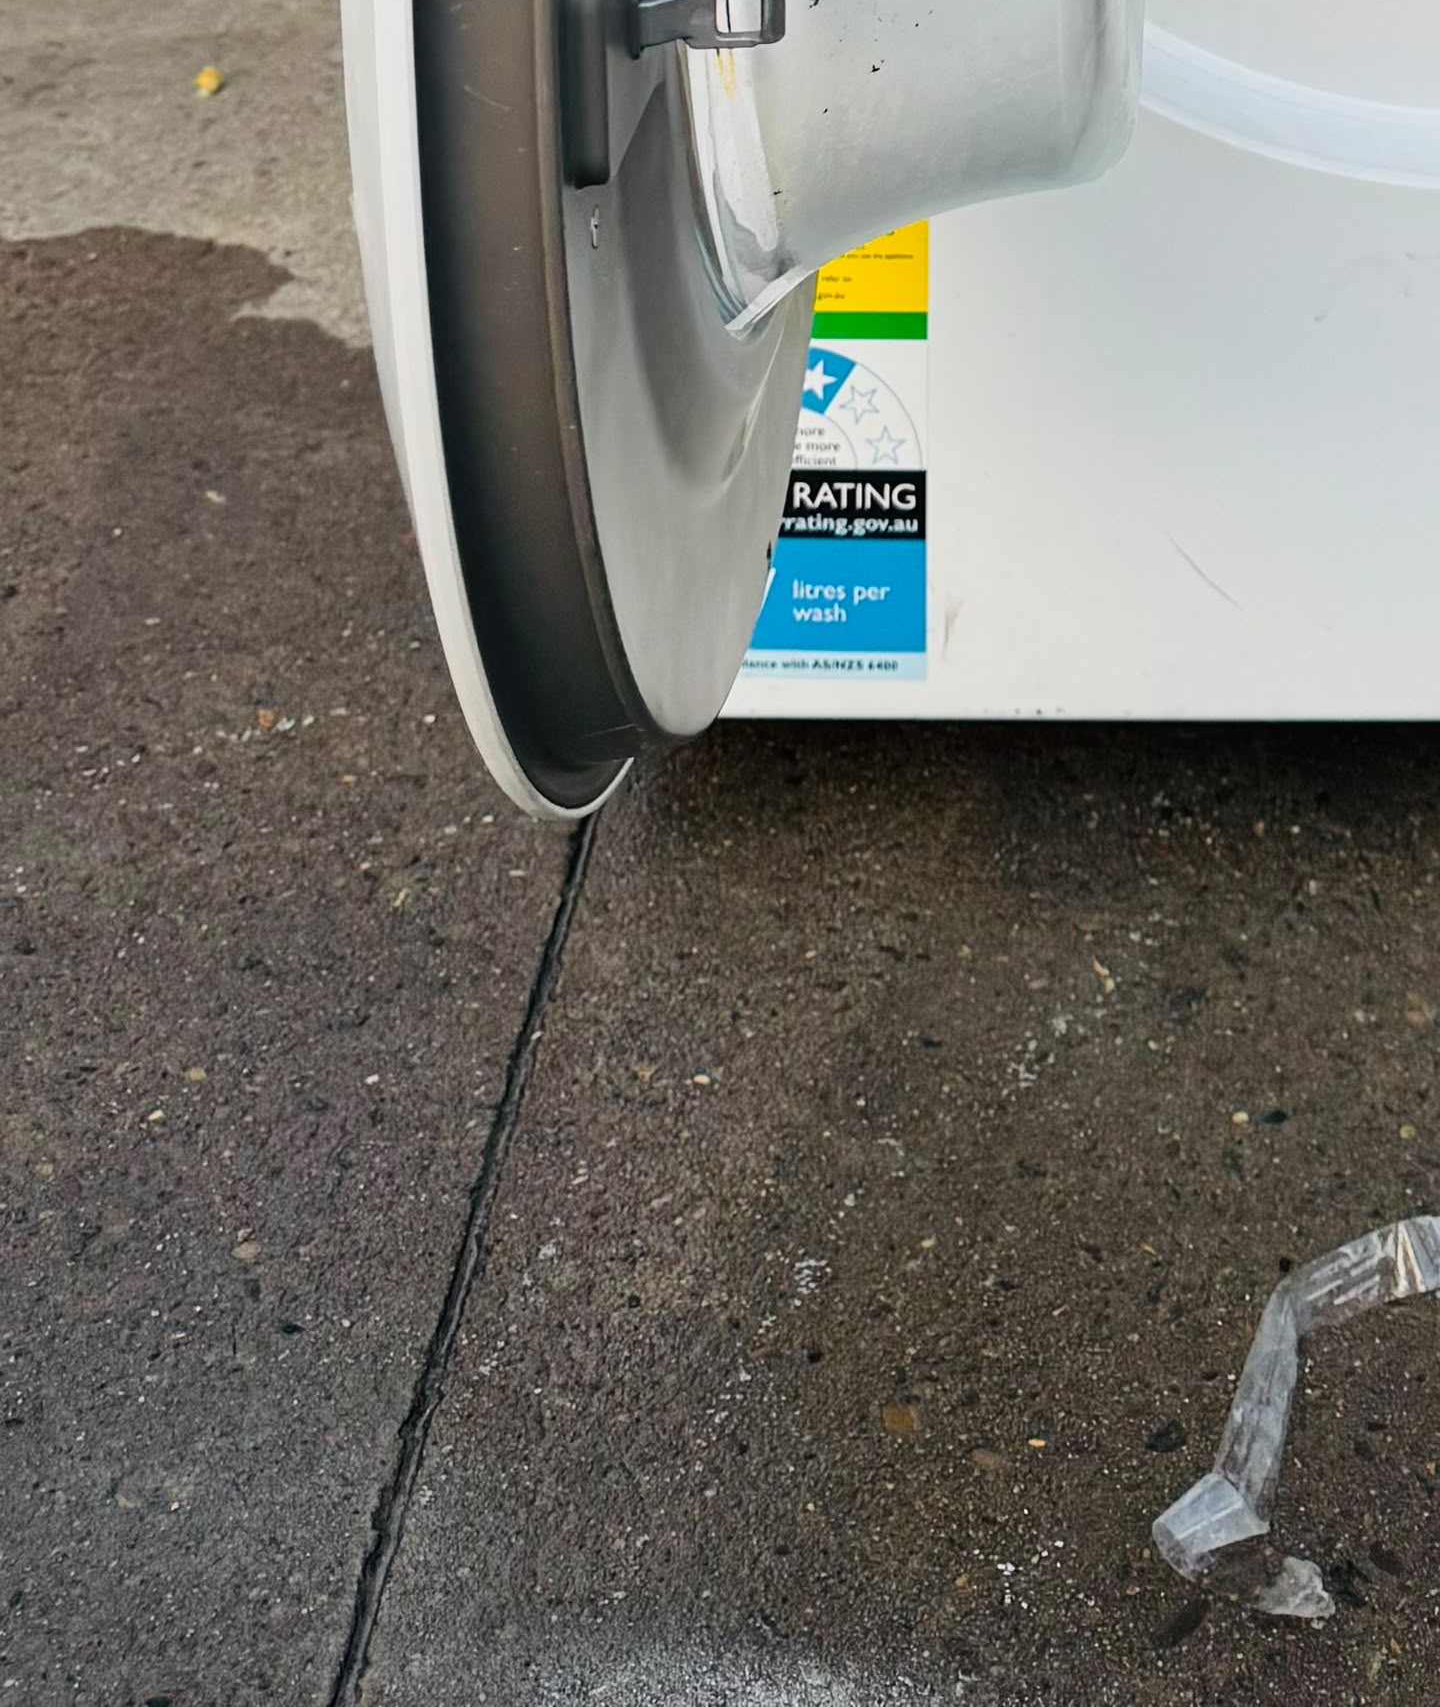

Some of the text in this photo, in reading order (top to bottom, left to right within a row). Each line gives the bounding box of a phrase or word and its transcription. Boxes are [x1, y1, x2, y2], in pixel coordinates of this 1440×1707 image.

[806, 443, 840, 452] more
[795, 455, 836, 466] fficient
[793, 481, 917, 510] RATING
[782, 513, 919, 536] rating.gov.au
[792, 579, 890, 605] litres per
[792, 602, 847, 622] wash
